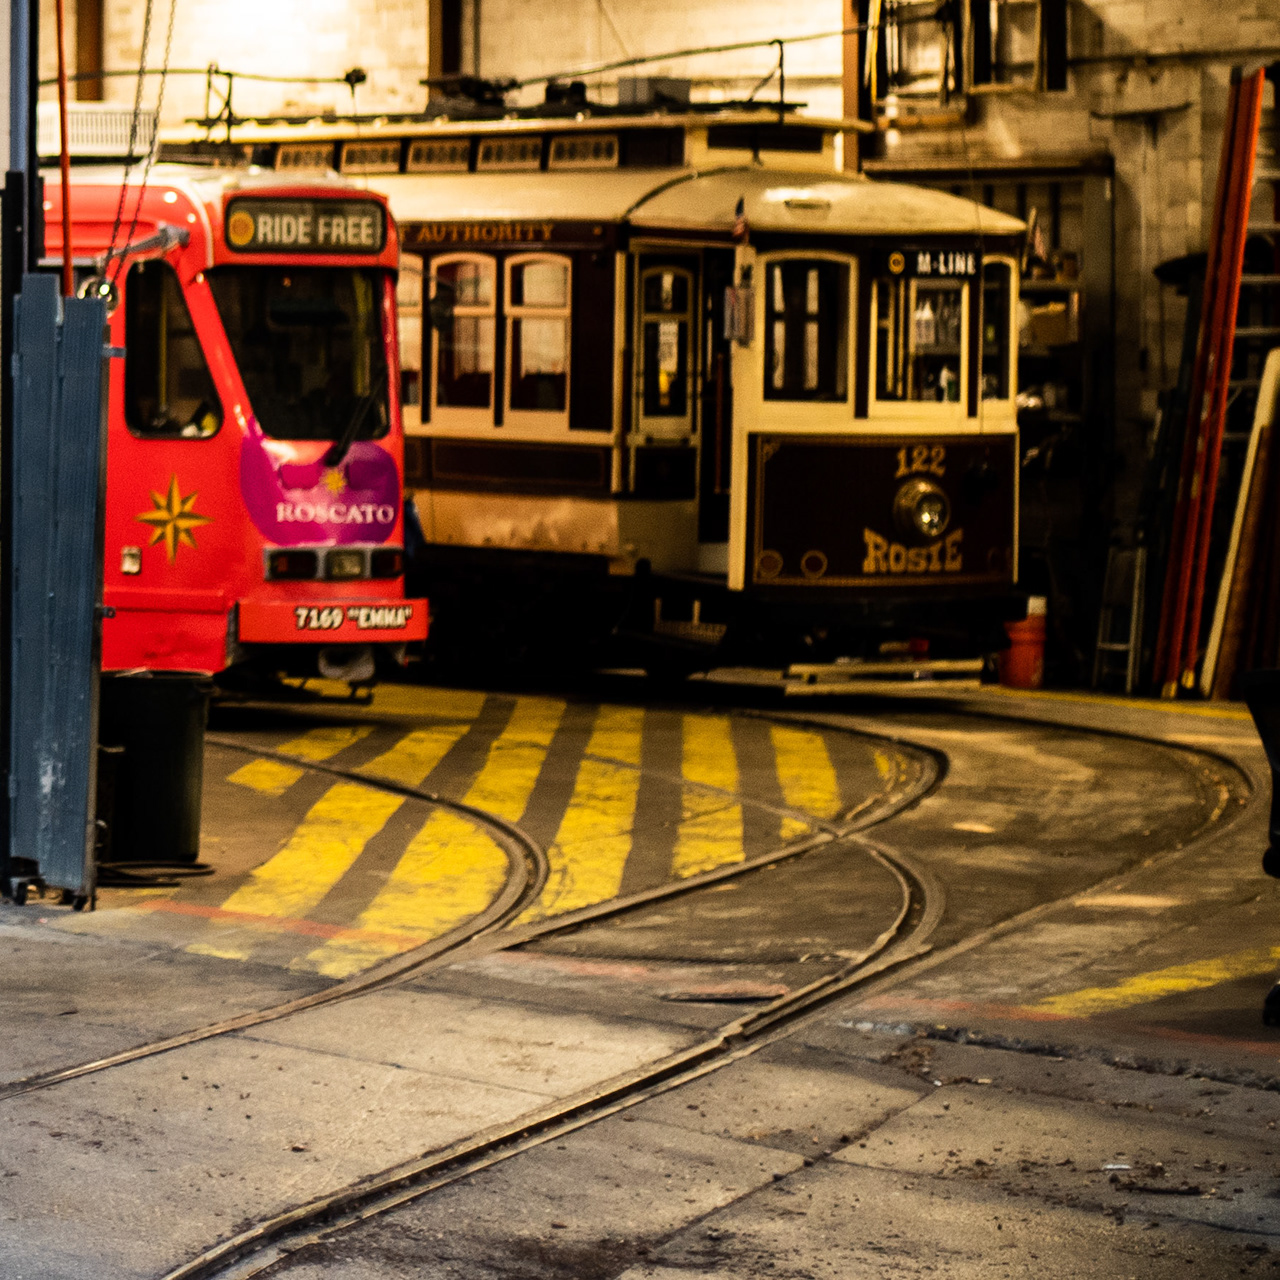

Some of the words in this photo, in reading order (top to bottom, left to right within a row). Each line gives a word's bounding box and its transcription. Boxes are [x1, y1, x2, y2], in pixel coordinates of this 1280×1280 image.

[256, 214, 312, 244] RIDE
[318, 215, 374, 245] FREE
[417, 222, 555, 242] AUTHORITY
[895, 444, 947, 479] 122
[276, 502, 396, 525] ROSCATO
[295, 605, 344, 630] 7169
